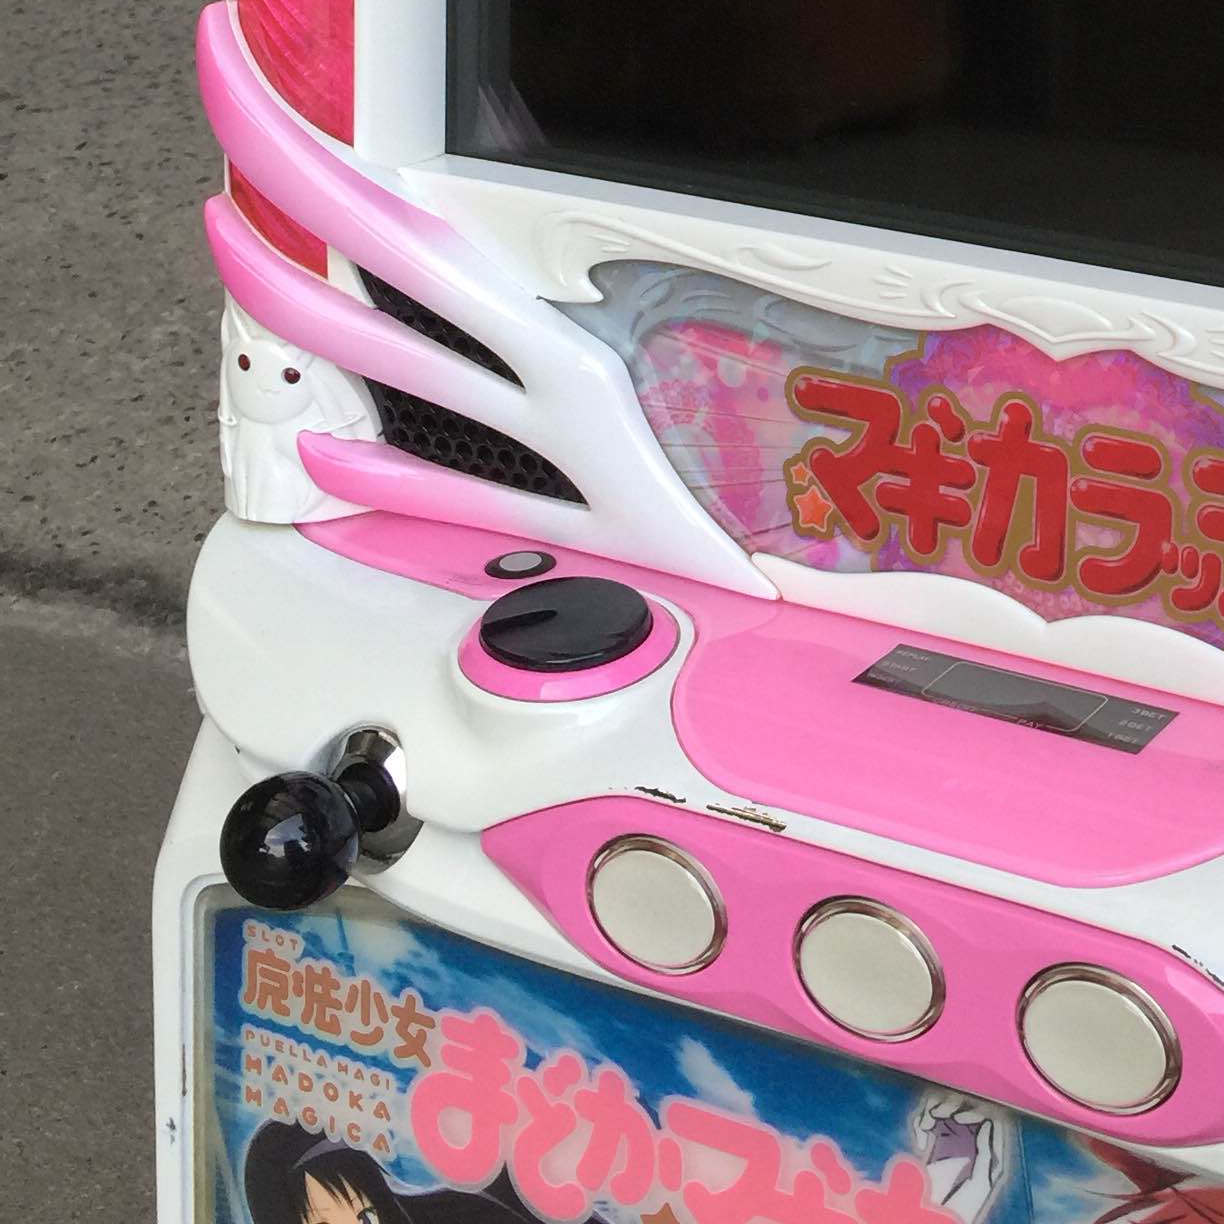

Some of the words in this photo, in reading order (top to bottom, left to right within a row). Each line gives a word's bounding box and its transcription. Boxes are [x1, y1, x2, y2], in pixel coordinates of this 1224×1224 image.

[245, 924, 299, 952] SLOT
[245, 1029, 329, 1069] PUELLA
[337, 1060, 392, 1091] MAGI
[245, 1053, 392, 1123] MADOKA
[245, 1085, 392, 1154] MAGICA
